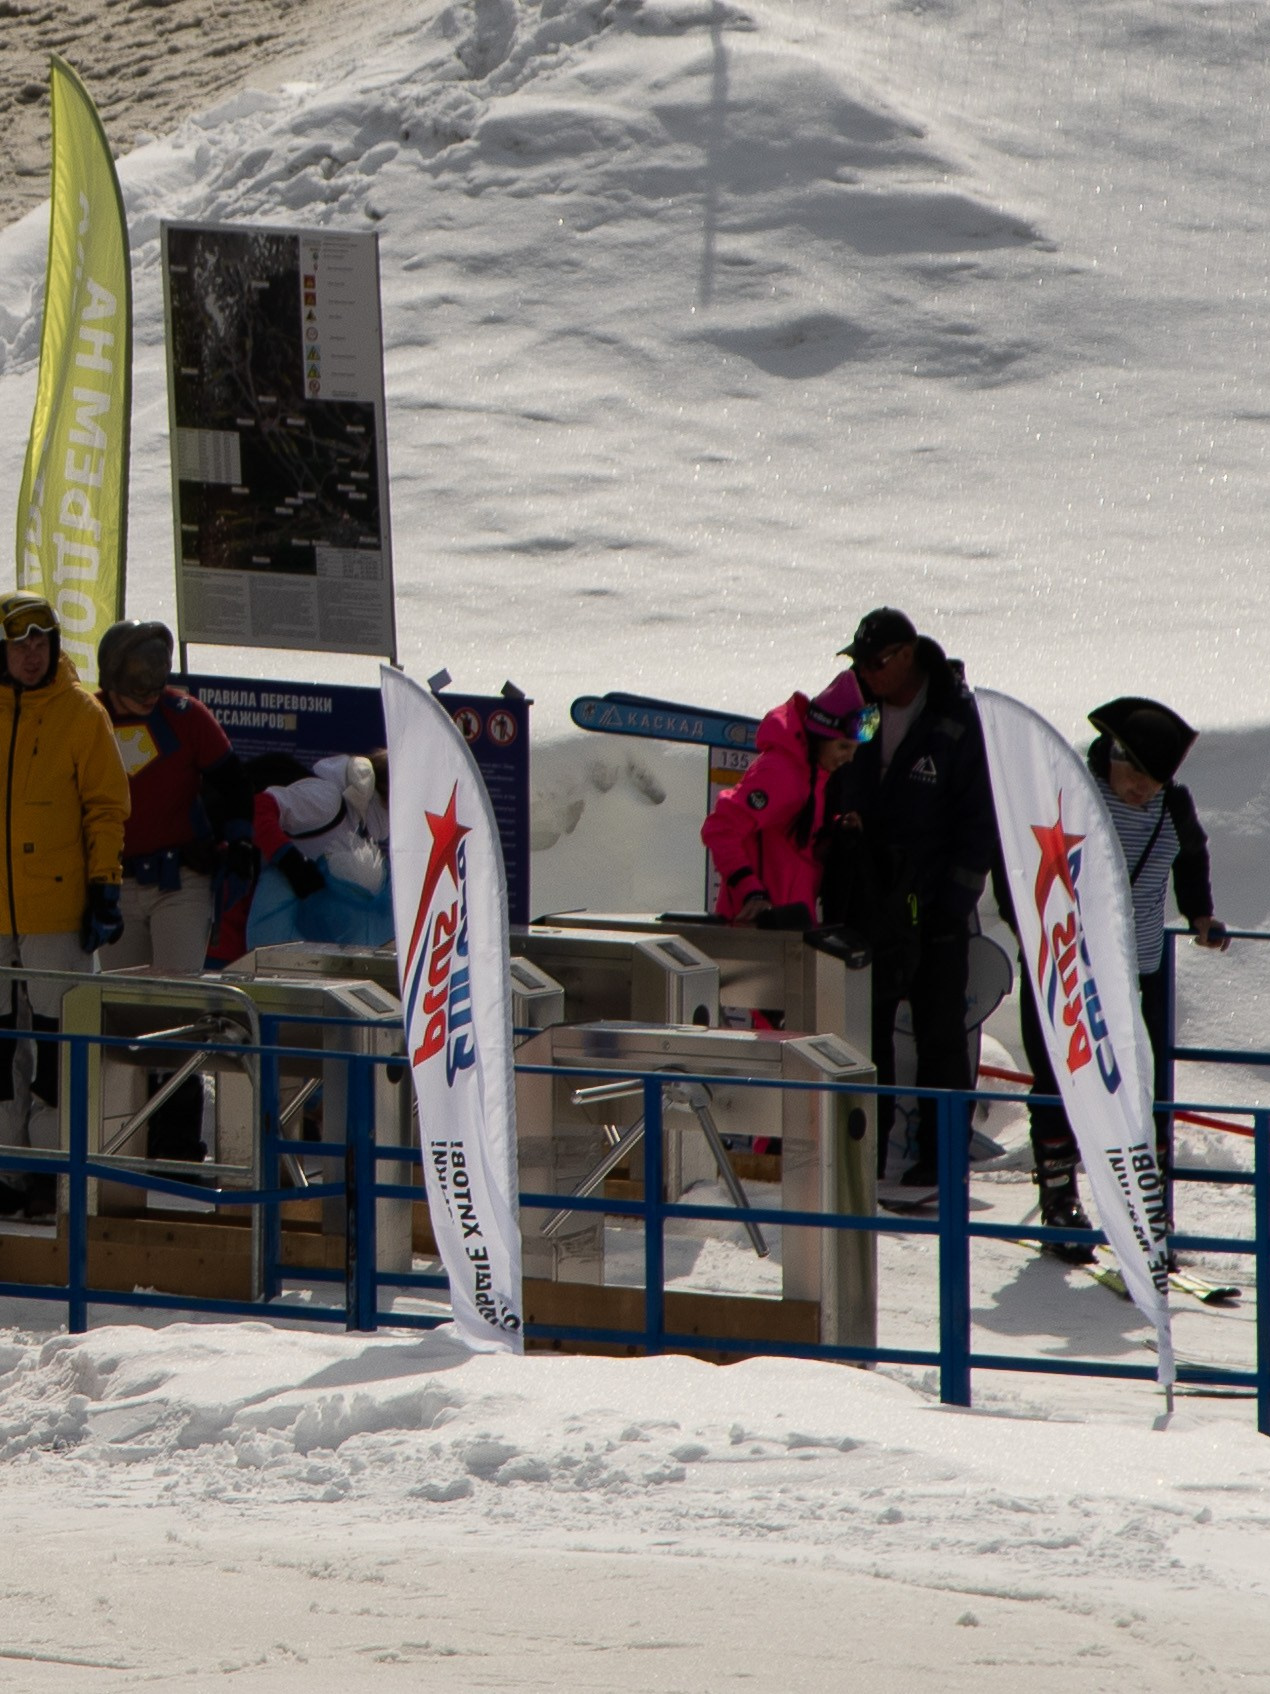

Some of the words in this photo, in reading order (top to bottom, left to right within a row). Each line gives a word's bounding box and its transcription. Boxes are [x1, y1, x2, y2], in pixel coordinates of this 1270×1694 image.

[198, 688, 257, 707] ПРАВИЛА
[261, 692, 332, 713] ПЕРЕВОЗКИ
[209, 708, 285, 729] ССАЖИРОВ
[628, 712, 704, 738] КАСКАД
